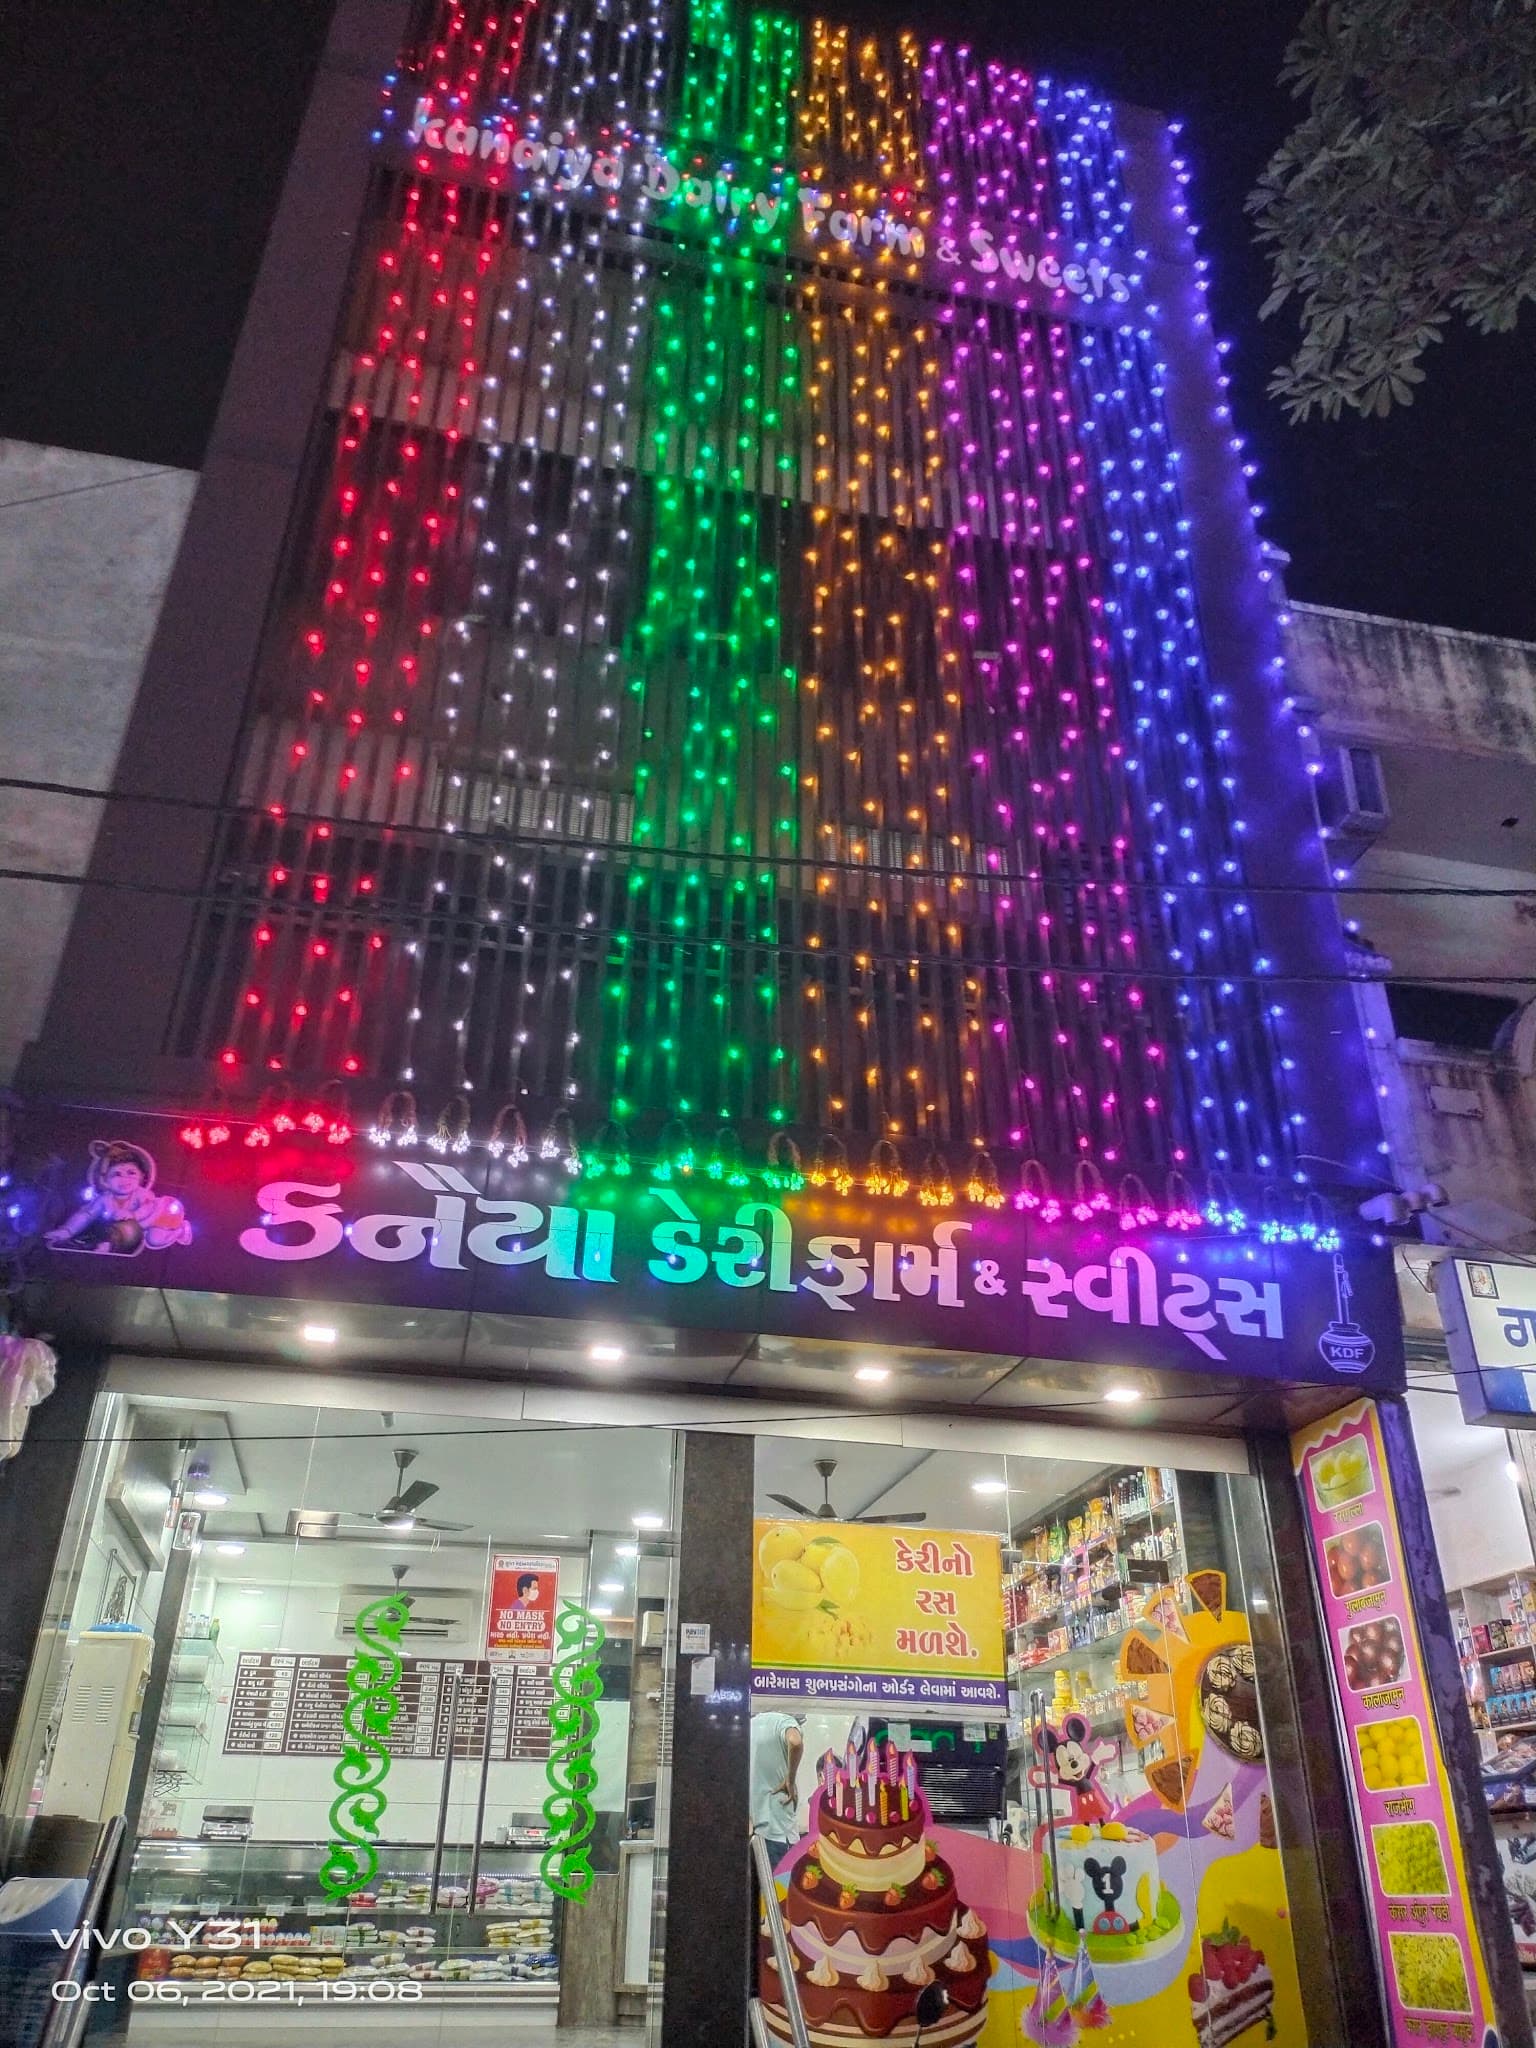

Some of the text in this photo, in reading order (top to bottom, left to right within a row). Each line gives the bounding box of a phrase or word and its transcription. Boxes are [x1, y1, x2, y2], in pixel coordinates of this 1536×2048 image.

[641, 151, 782, 236] Dairy
[938, 236, 963, 265] &
[969, 228, 1133, 306] Sweets
[240, 1161, 618, 1283] કનૈયા
[975, 1259, 1007, 1296] &
[1331, 1345, 1364, 1359] KDF
[894, 1537, 972, 1576] કેરીનો
[499, 1610, 545, 1621] NO MASK
[914, 1590, 957, 1616] રસ
[500, 1621, 543, 1630] NO ENTRY
[897, 1624, 977, 1656] મળશે.
[753, 1674, 1002, 1700] બારેમાસ શુભપ્રસંગોના ઓર્ડર લેવામાં આવશે.
[1101, 1873, 1114, 1894] 1
